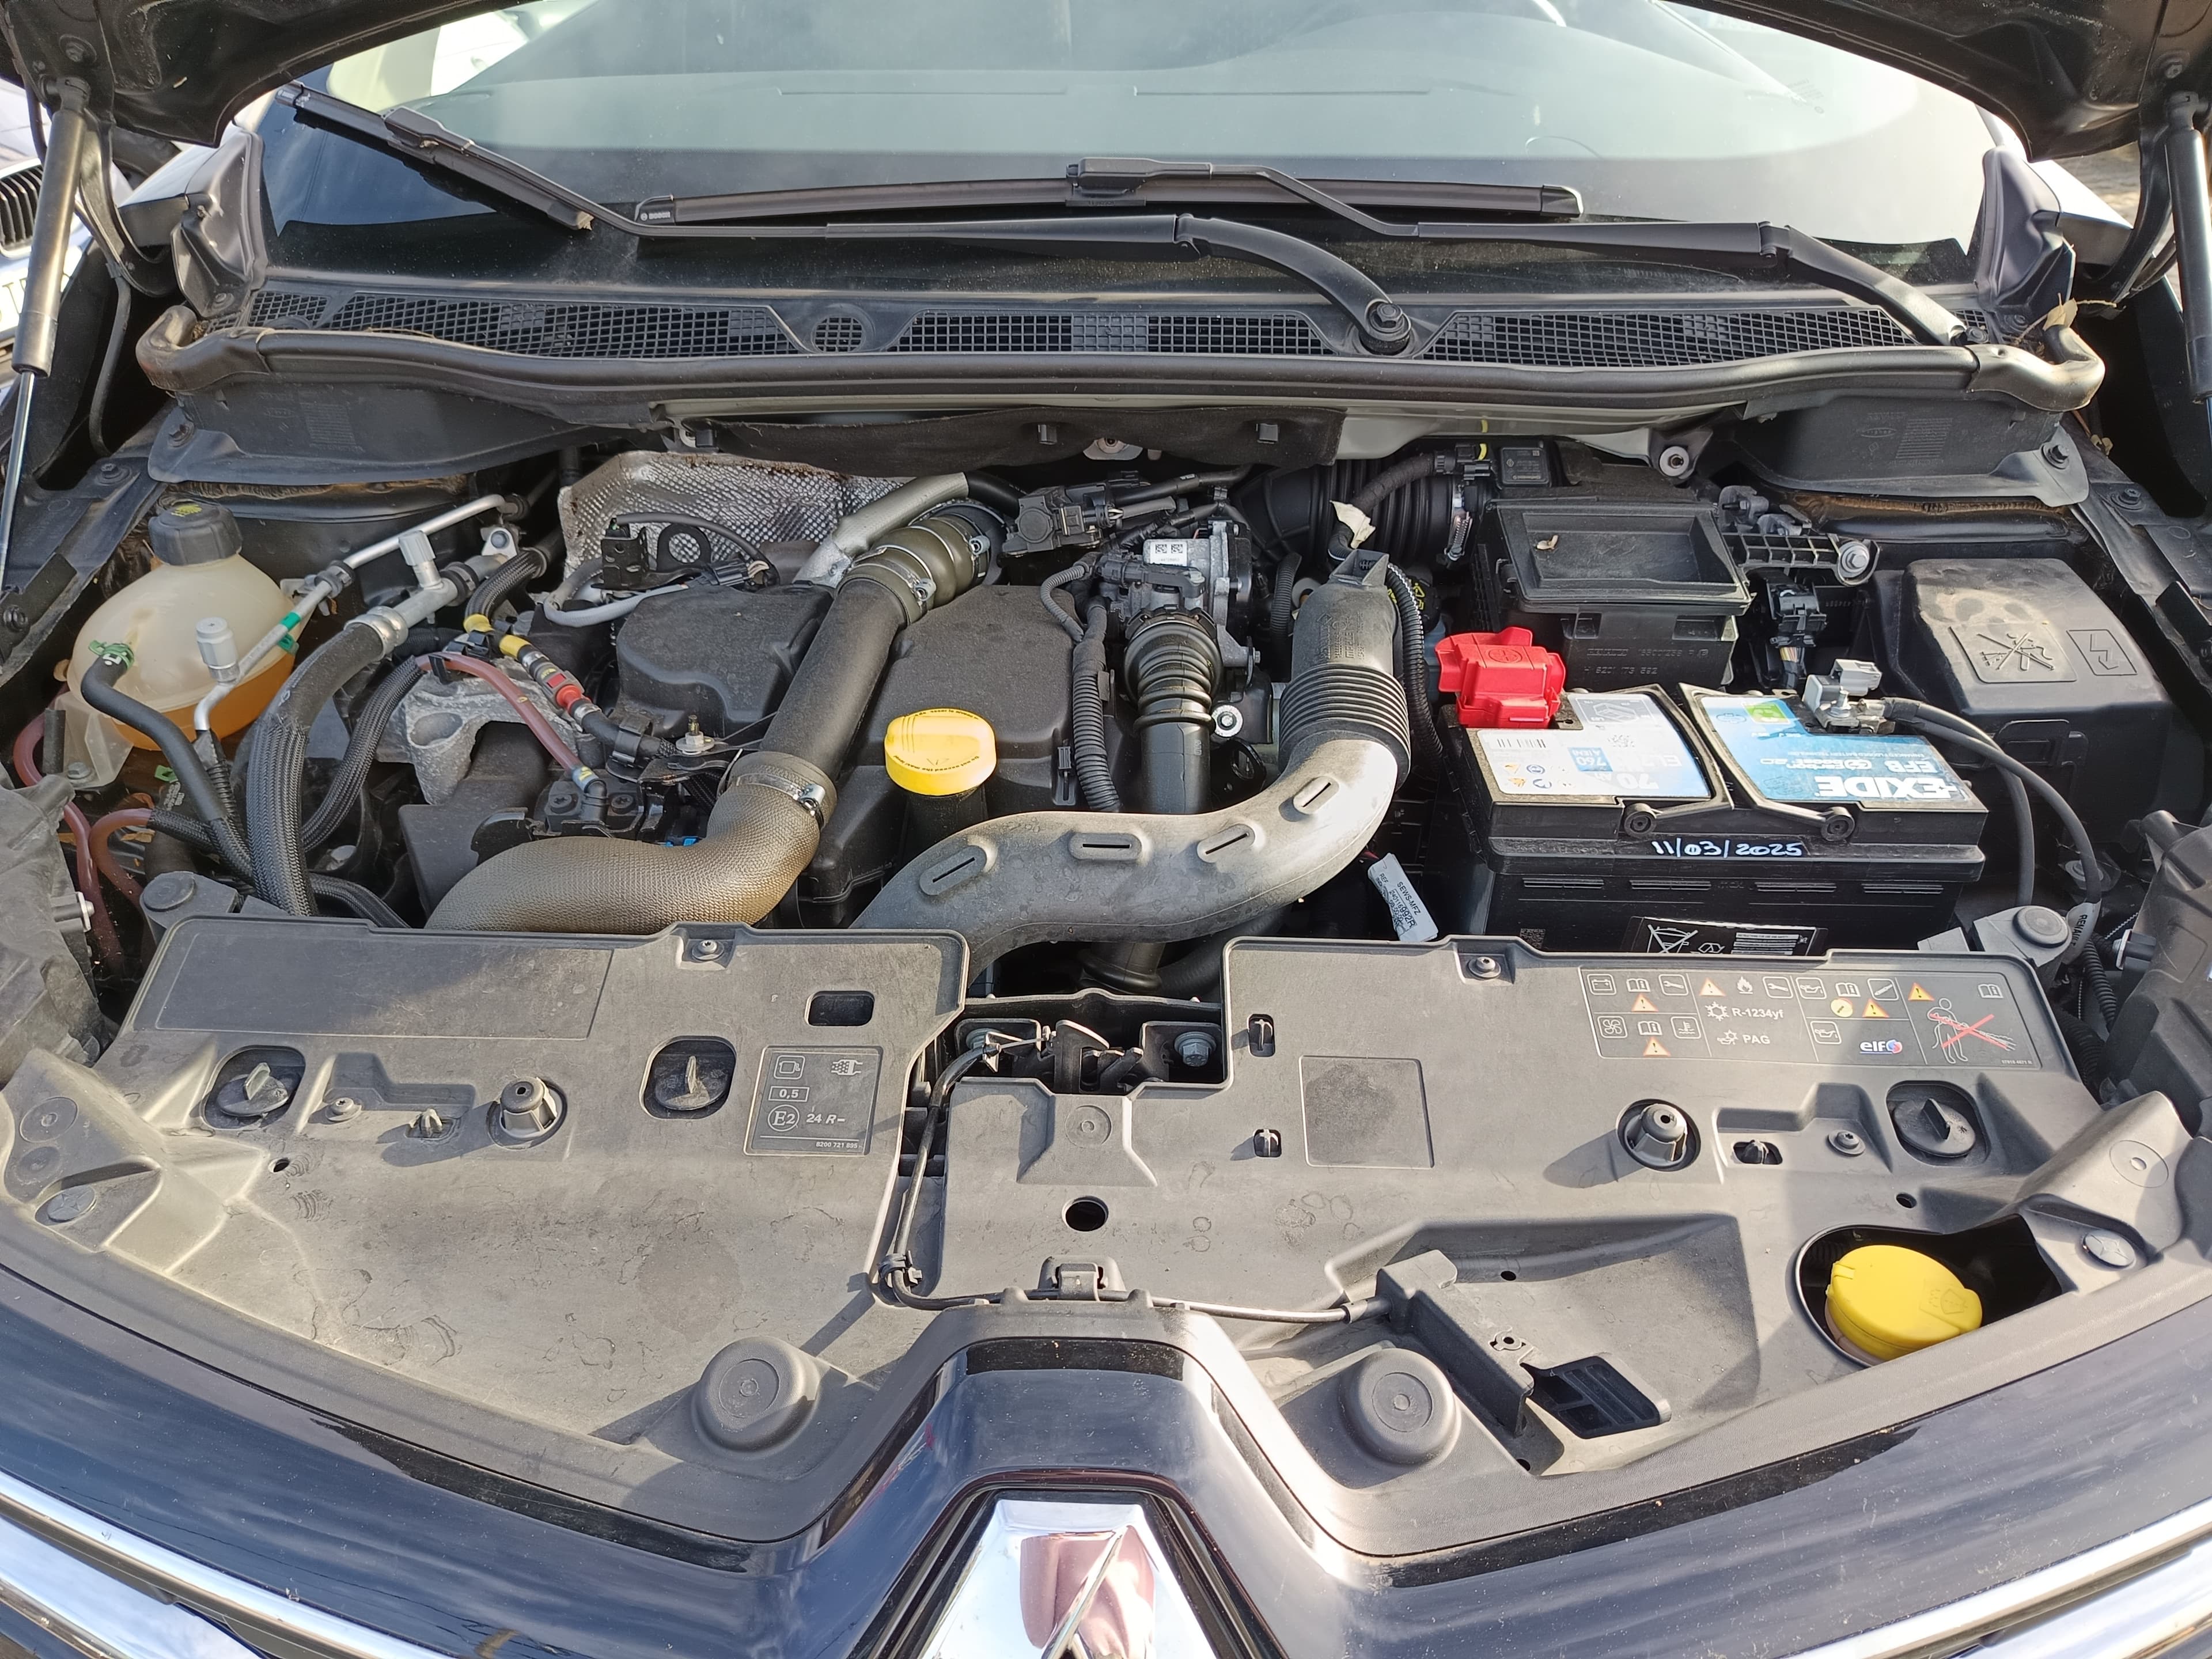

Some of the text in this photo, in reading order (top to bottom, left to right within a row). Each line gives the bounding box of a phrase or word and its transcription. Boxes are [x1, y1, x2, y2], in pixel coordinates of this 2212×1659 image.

[1577, 756, 1606, 766] 760
[1884, 760, 1938, 773] EFB
[1616, 772, 1660, 789] 70
[1814, 775, 1957, 799] EXIDE
[1651, 837, 1803, 859] 11/03/2025
[1397, 881, 1421, 915] SEWS-MFZ
[1389, 890, 1416, 927] 240116992R
[1733, 1007, 1784, 1021] R-1234yf
[1743, 1035, 1771, 1045] PAG
[1859, 1039, 1888, 1053] elf
[779, 1089, 800, 1099] 0,5
[772, 1111, 796, 1126] E2
[806, 1113, 822, 1124] 24
